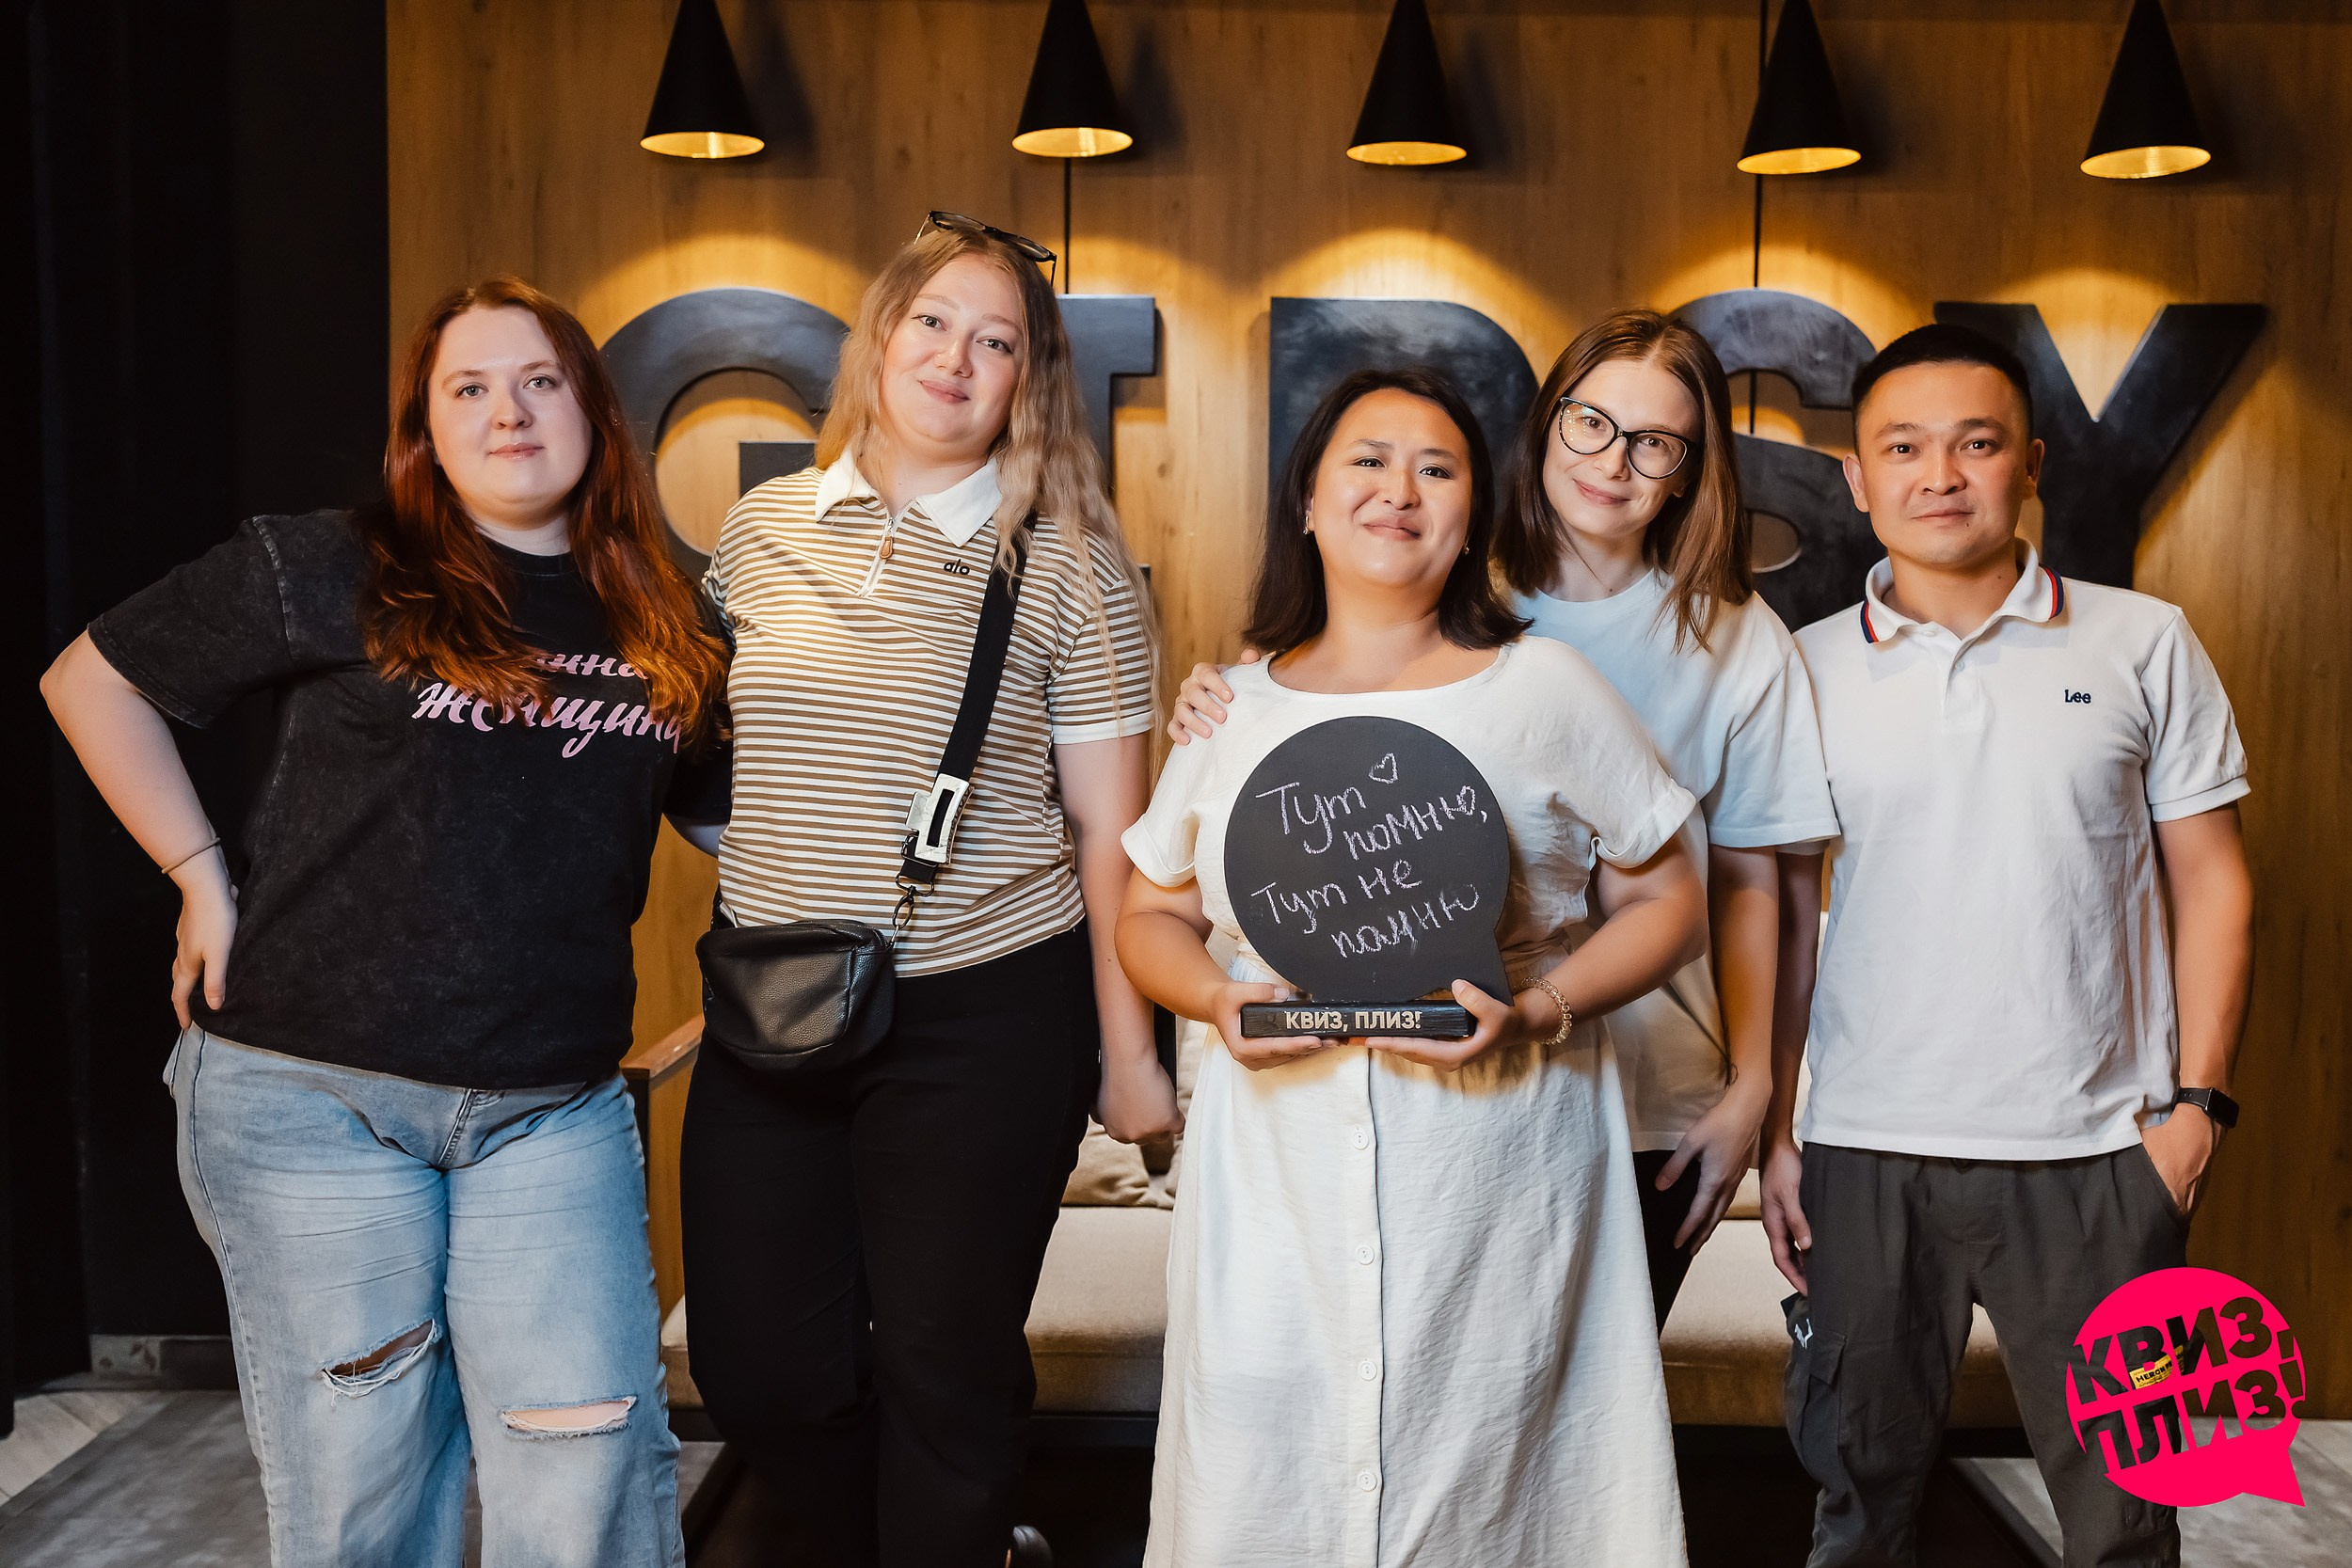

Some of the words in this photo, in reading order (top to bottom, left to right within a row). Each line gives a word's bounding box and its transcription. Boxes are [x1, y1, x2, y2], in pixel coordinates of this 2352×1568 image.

[944, 559, 970, 576] alo
[2064, 689, 2091, 704] Lee
[1255, 782, 1366, 855] Тут
[1250, 881, 1348, 935] Тут
[1285, 1010, 1349, 1033] КВИЗ,
[1355, 1010, 1422, 1030] ПЛИЗ!
